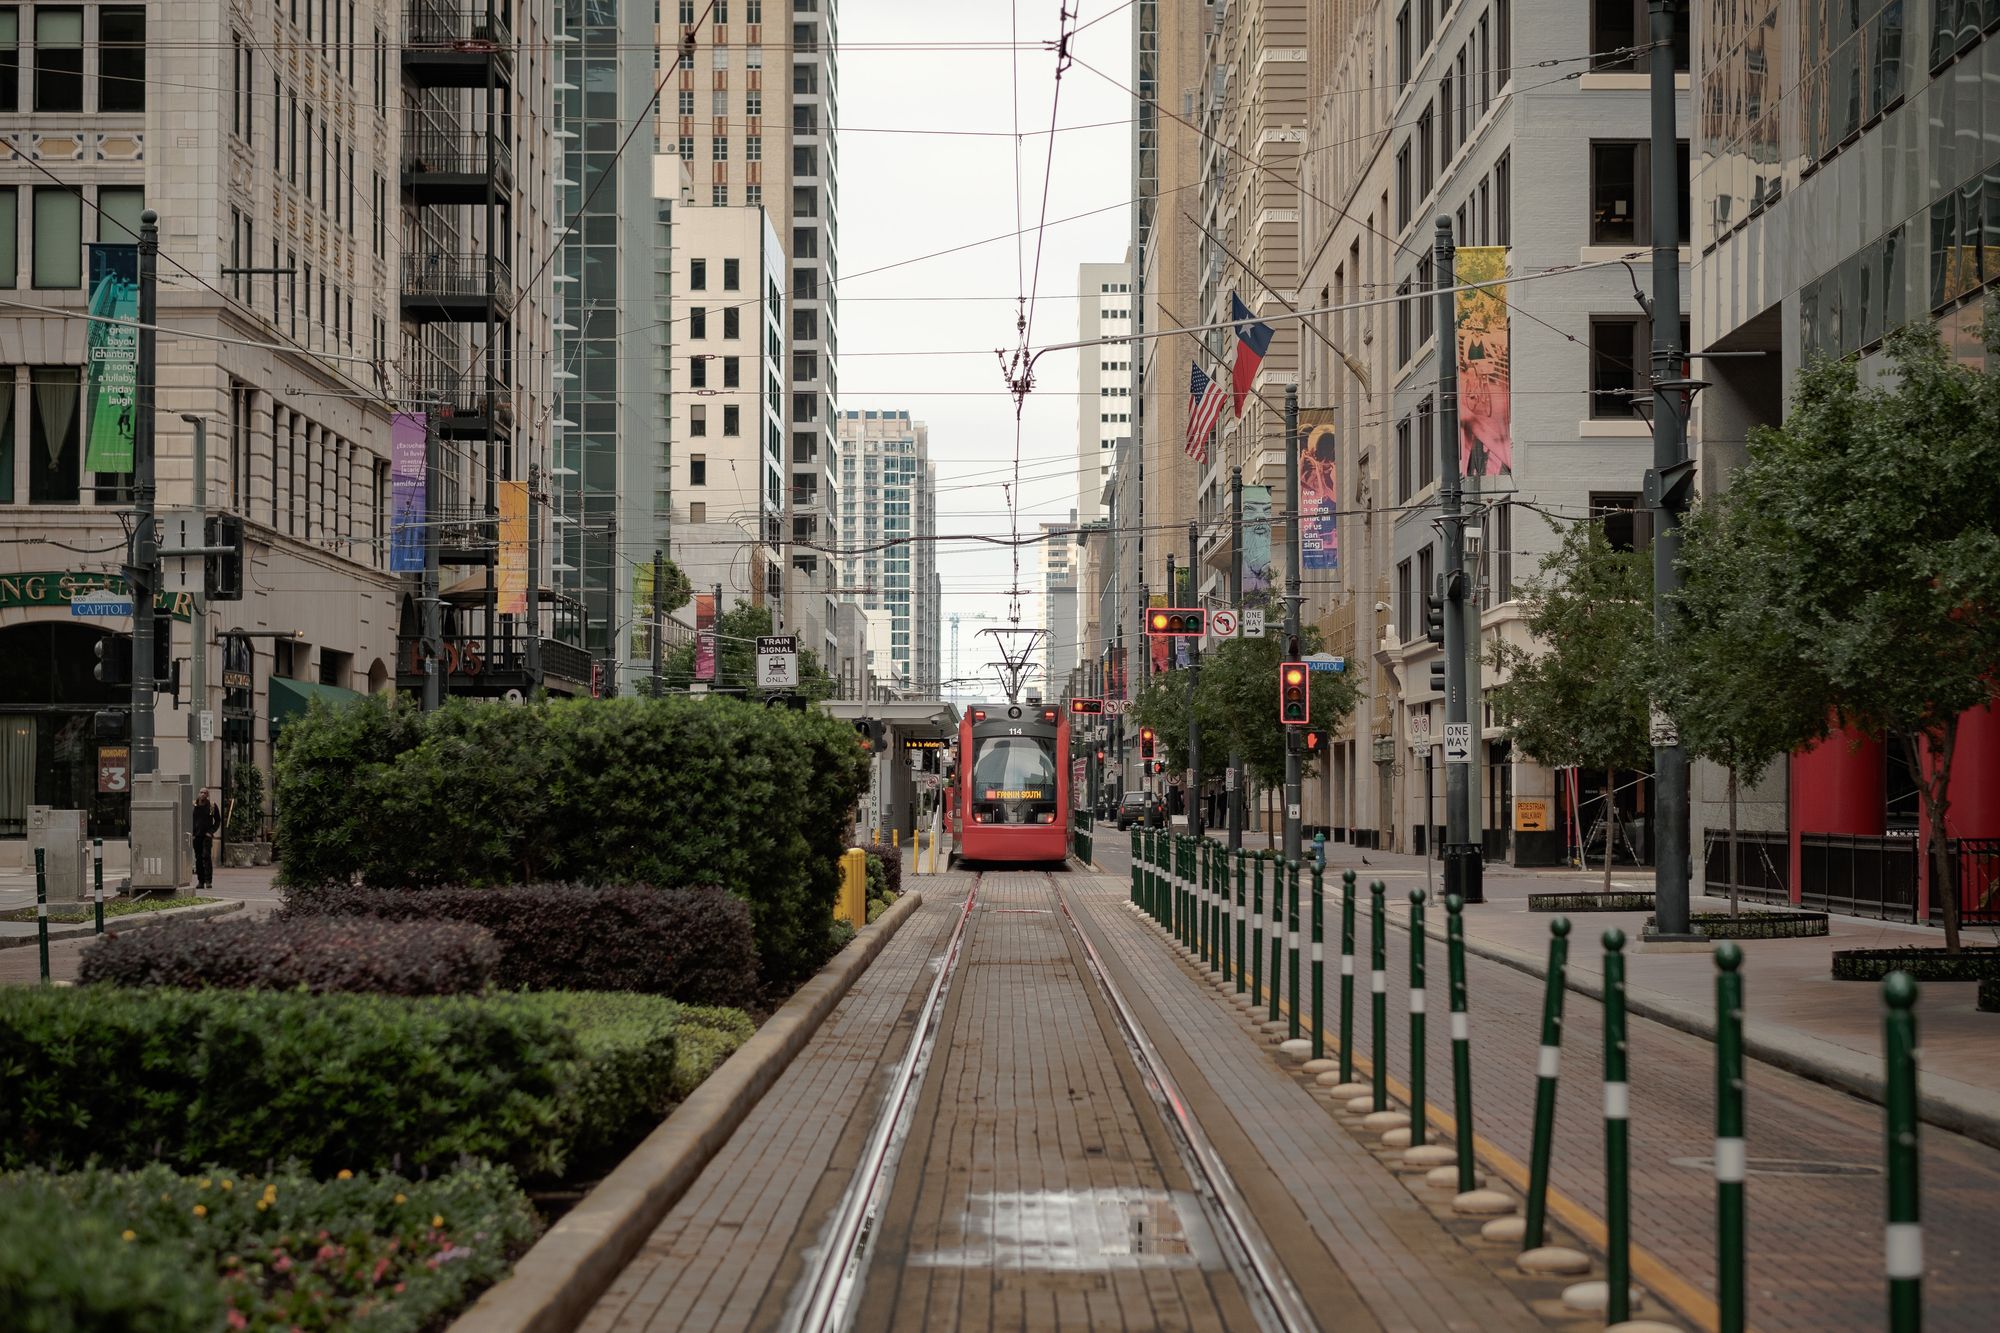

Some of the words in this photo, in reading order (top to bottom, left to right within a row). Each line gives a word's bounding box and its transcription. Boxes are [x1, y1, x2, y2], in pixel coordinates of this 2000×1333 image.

[109, 326, 134, 336] green
[108, 336, 134, 347] bayou
[95, 348, 134, 359] chanting
[108, 385, 134, 395] Friday
[109, 396, 133, 406] laugh
[1304, 540, 1320, 548] sing
[78, 604, 126, 615] CAPITOL
[1447, 727, 1468, 735] ONE
[1447, 738, 1469, 746] WAY
[102, 767, 125, 790] $3
[996, 790, 1020, 798] FANNIN
[1021, 790, 1041, 798] SOUTH
